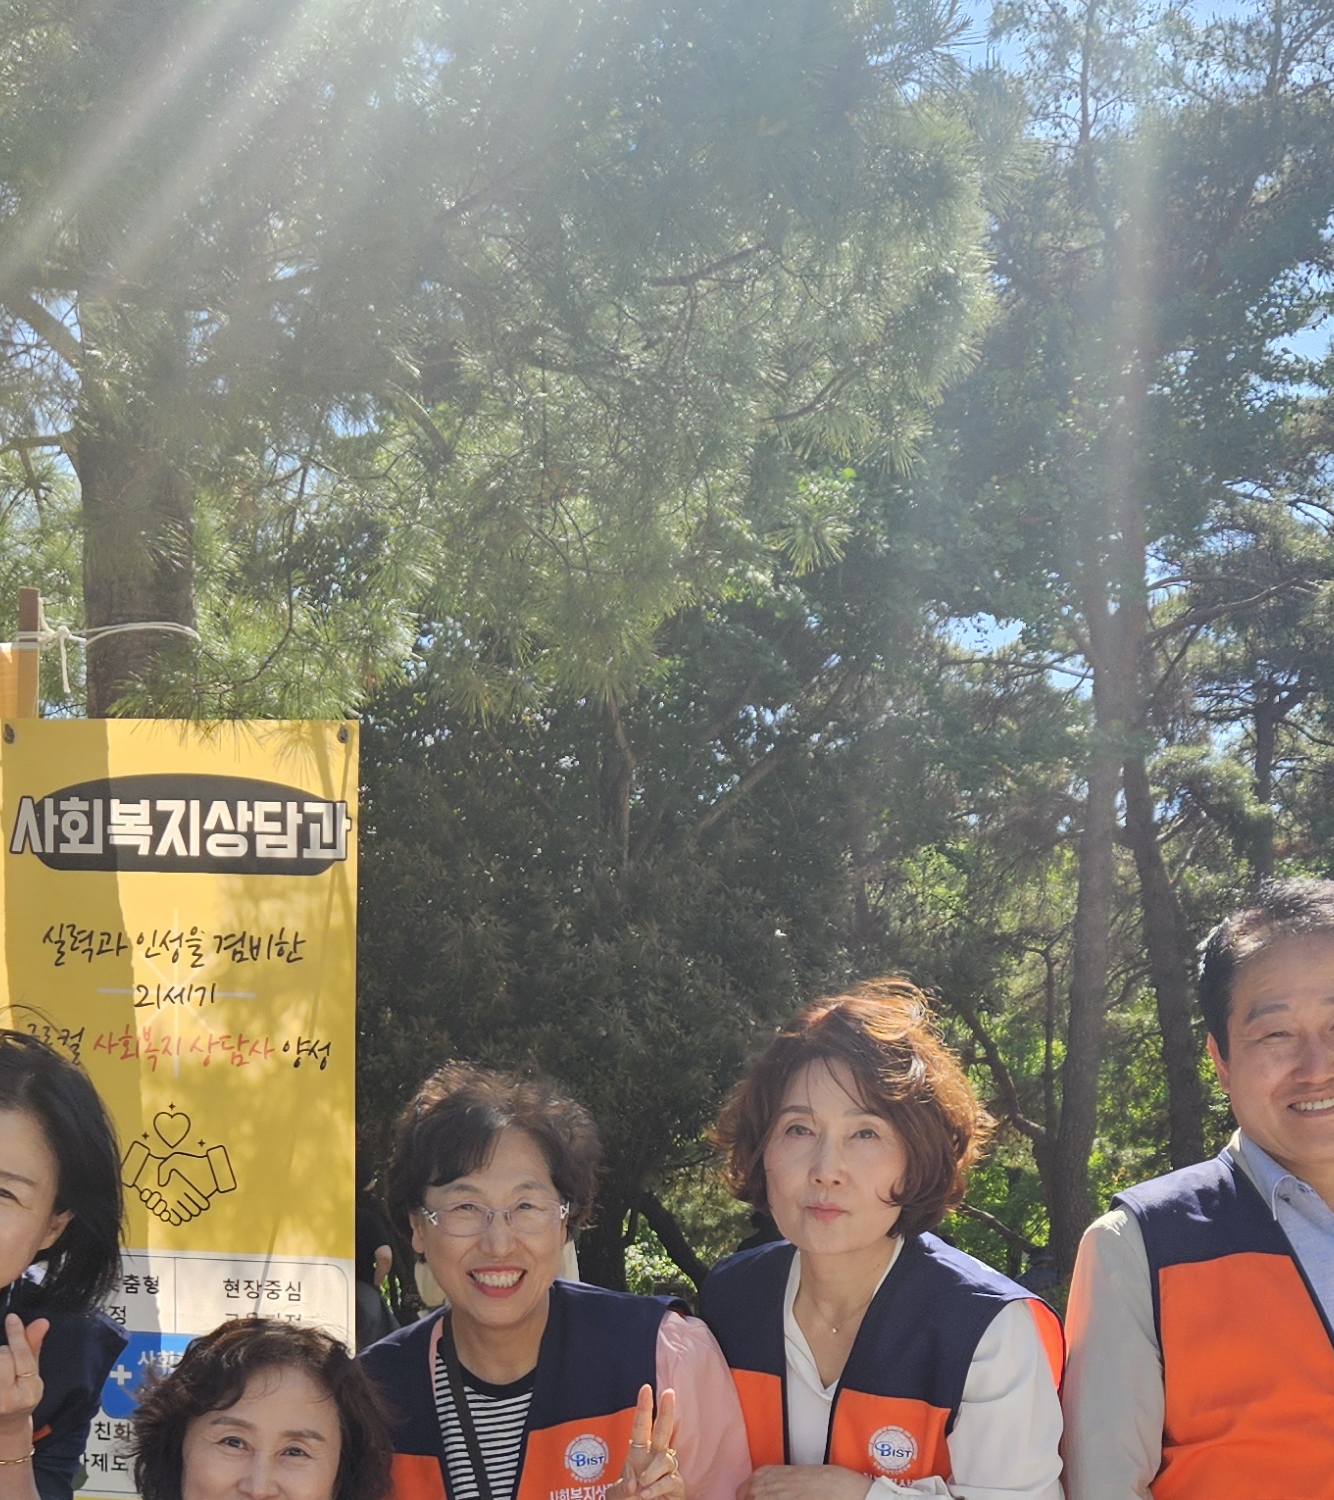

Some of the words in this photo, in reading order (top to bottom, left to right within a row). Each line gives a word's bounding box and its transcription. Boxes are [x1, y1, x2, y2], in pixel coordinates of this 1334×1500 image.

[10, 796, 352, 861] 사회복지상담과
[43, 923, 128, 967] 실력과
[136, 926, 205, 969] 인성을
[213, 927, 306, 964] 겸비한
[134, 983, 216, 1009] 21세기
[93, 1024, 181, 1072] 사회복지
[190, 1032, 275, 1068] 상담사
[282, 1036, 332, 1071] 양성
[116, 1274, 160, 1295] 춤형
[223, 1278, 302, 1302] 현장중심
[570, 1451, 605, 1467] BIST
[875, 1441, 912, 1458] BIST
